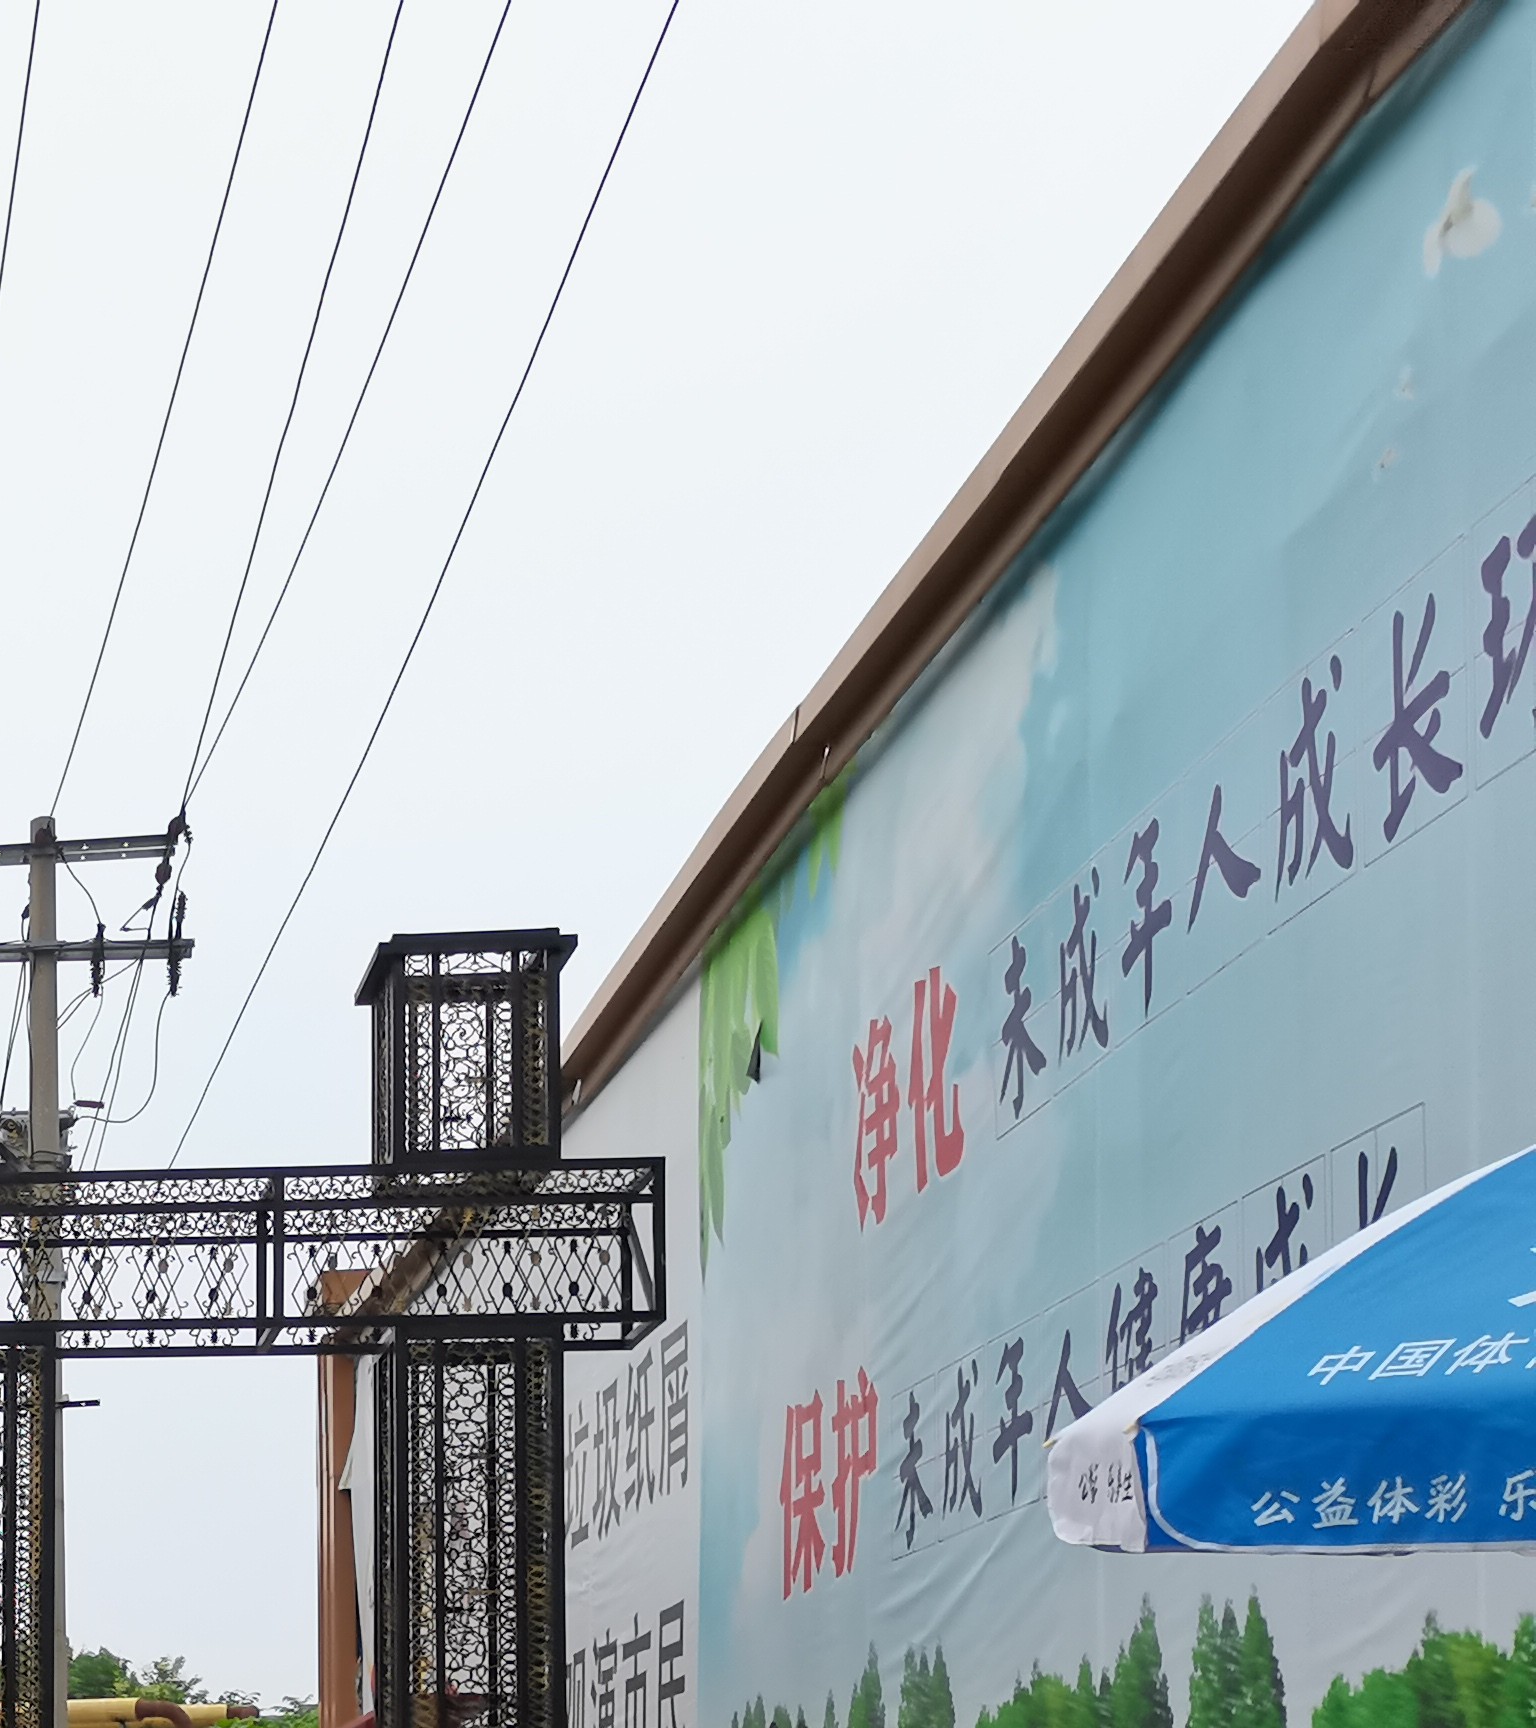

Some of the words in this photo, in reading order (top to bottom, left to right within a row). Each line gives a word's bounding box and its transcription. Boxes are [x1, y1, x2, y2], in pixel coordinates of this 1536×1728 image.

[853, 965, 964, 1233] 净化
[564, 1320, 689, 1550] 垃圾纸屑
[1308, 1331, 1536, 1386] 中国体
[779, 1366, 879, 1601] 保护
[1251, 1473, 1468, 1530] 公益体彩
